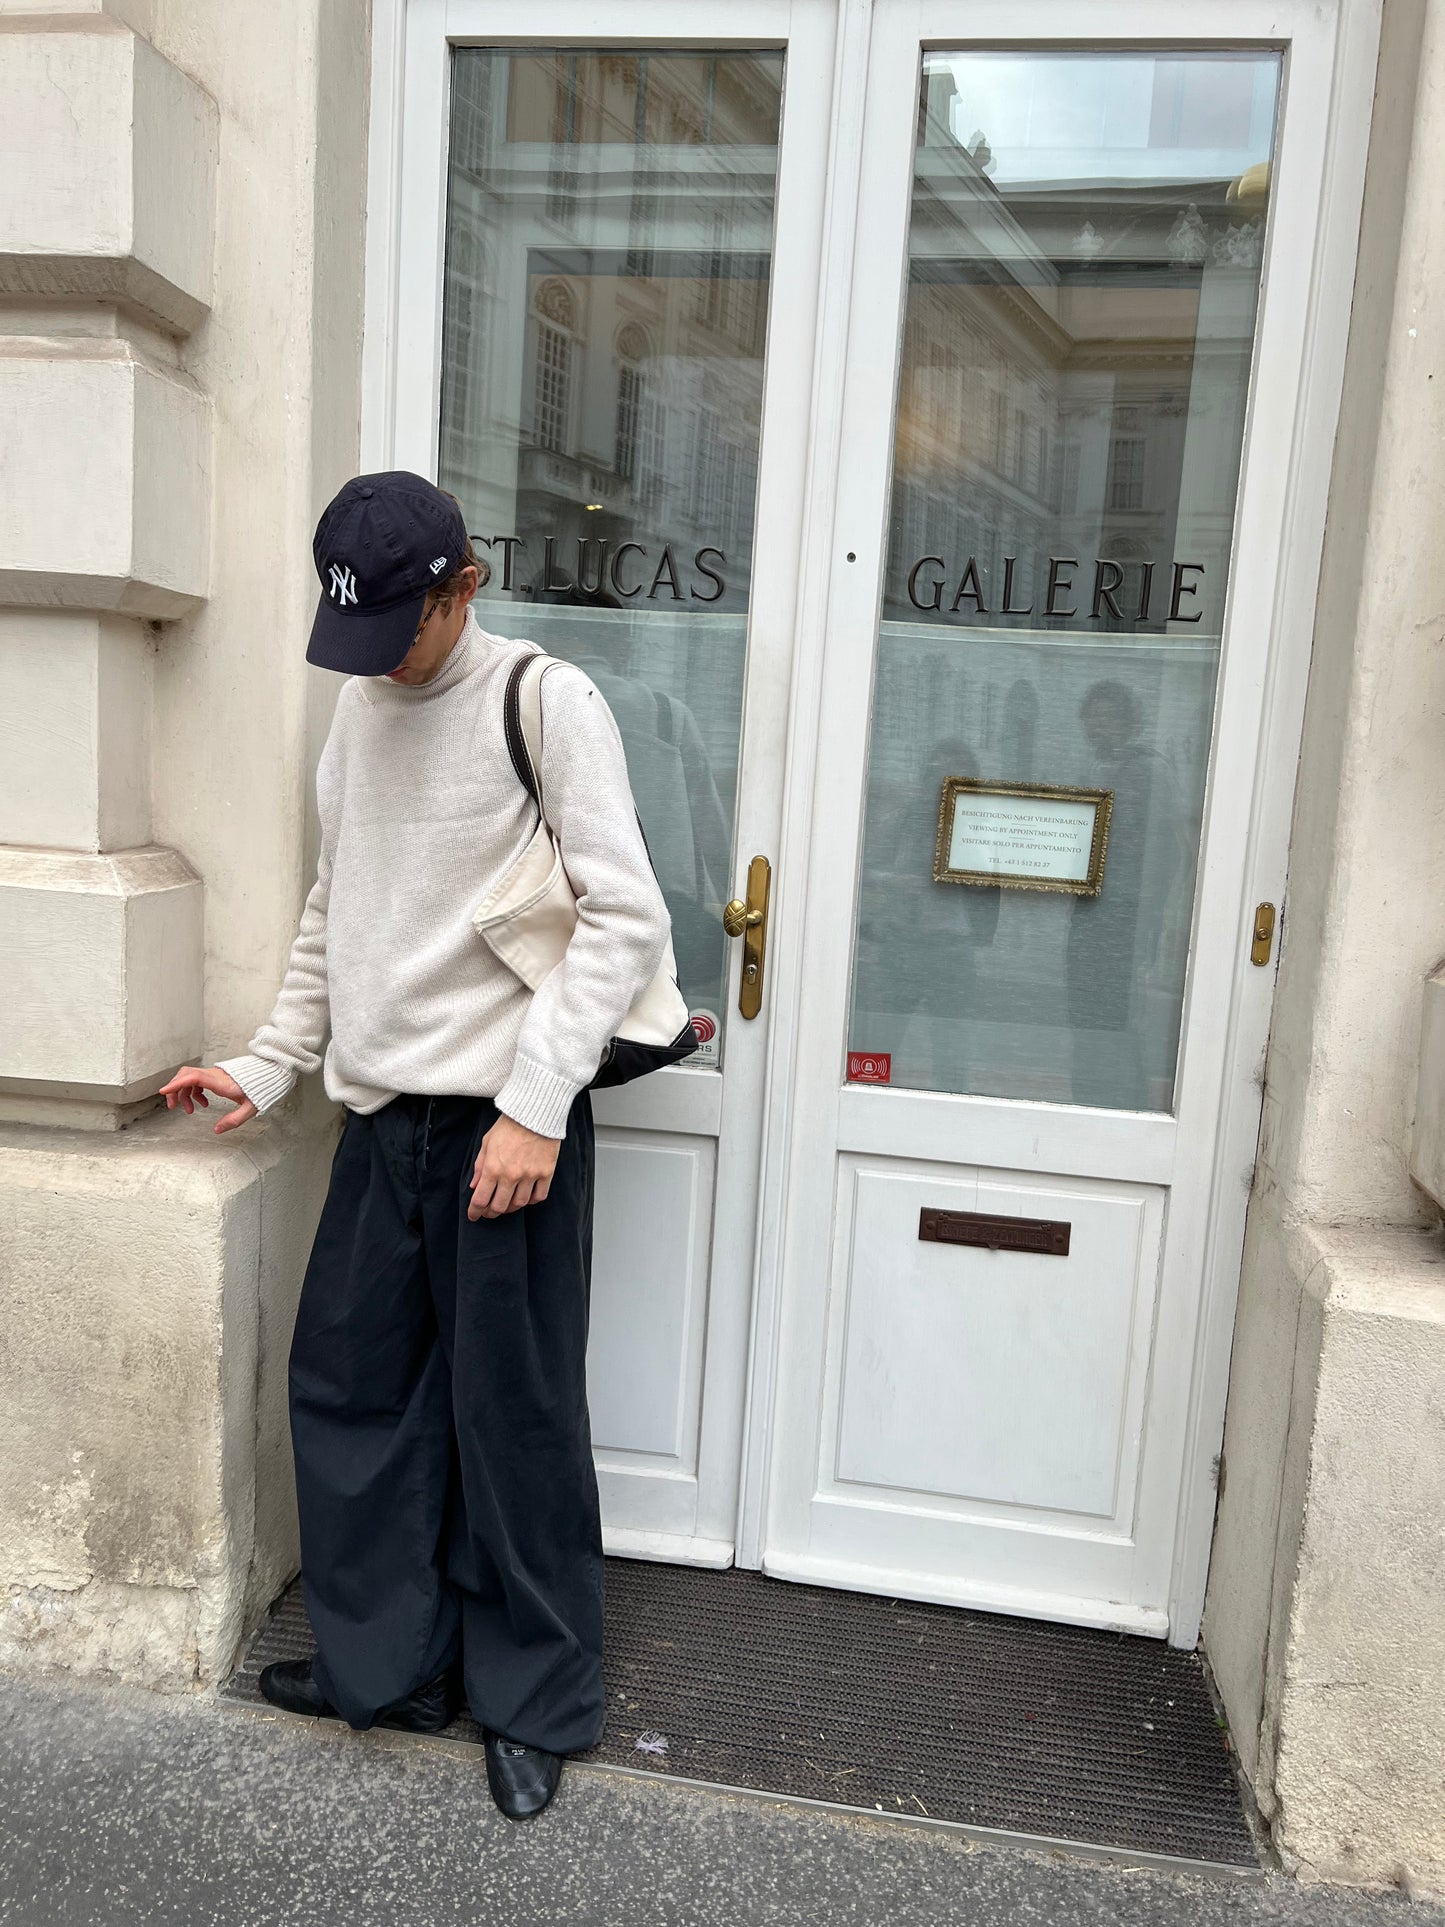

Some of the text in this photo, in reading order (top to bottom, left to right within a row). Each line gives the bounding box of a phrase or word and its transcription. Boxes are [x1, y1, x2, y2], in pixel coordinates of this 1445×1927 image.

[907, 555, 1205, 622] GALERIE
[961, 810, 1013, 820] BESICHTIGUNG
[1035, 816, 1089, 826] VEREINBARUNG
[968, 824, 998, 832] VIEWING
[1008, 828, 1058, 838] APPOINTMENT
[1058, 832, 1078, 840] ONLY
[961, 837, 991, 846] VISITARE
[992, 840, 1011, 848] SOLO
[1025, 843, 1082, 854] APPUNTAMENTO
